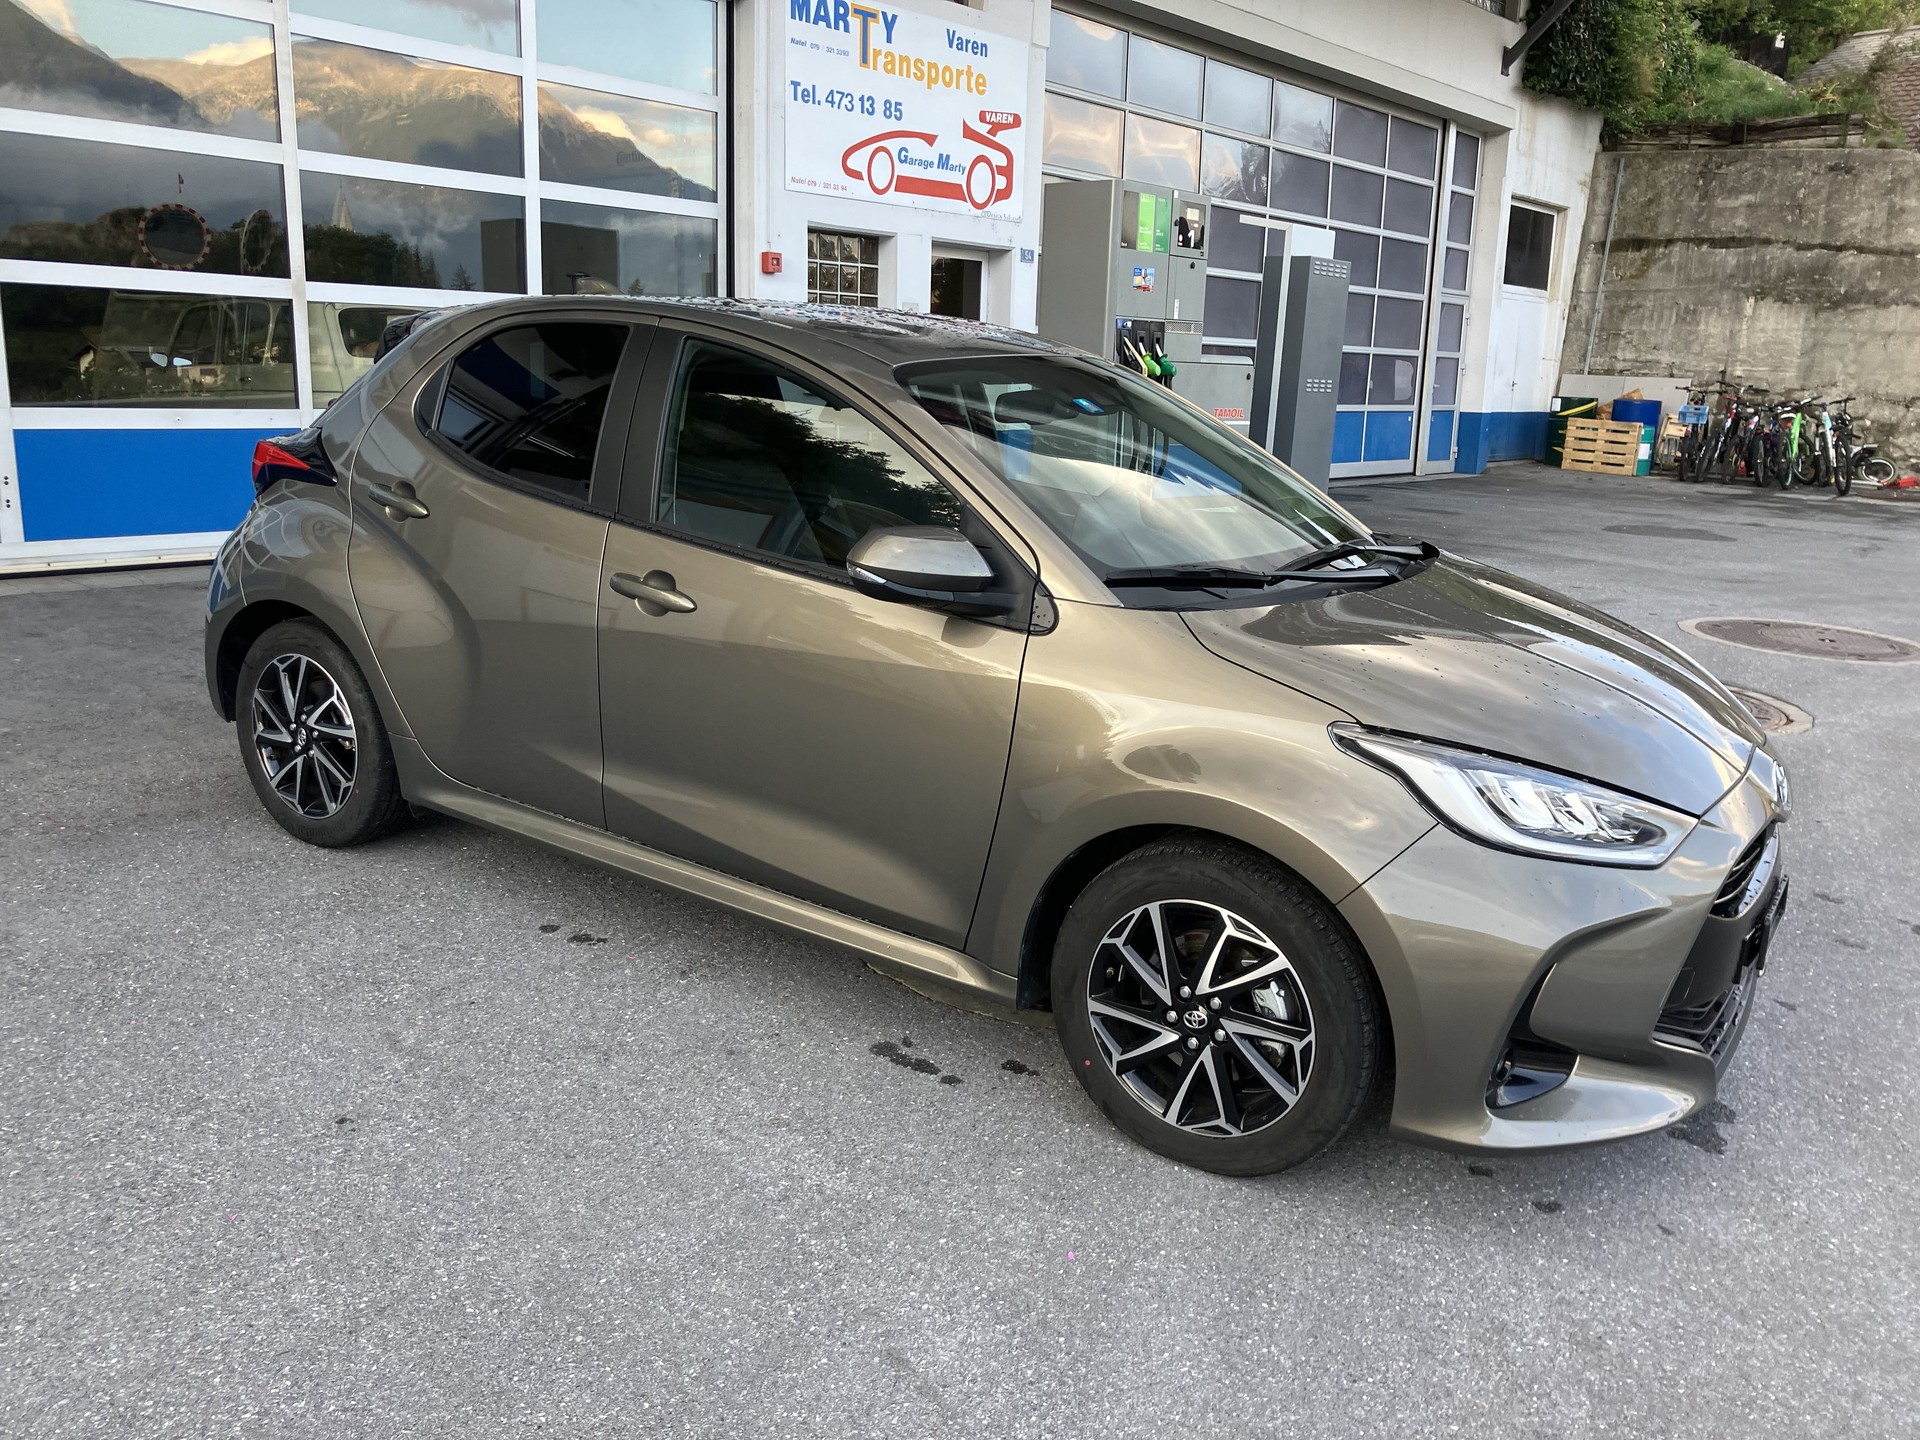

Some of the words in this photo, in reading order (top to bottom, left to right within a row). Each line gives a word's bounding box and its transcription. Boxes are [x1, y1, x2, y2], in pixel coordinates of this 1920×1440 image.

[790, 37, 807, 47] Natel
[791, 0, 898, 64] MARTY
[946, 28, 988, 58] Varen
[851, 3, 987, 96] Transporte
[790, 80, 821, 106] Tel.
[825, 89, 854, 112] 473
[858, 94, 875, 116] 13
[883, 99, 903, 121] 85
[985, 111, 1014, 124] VAREN
[897, 146, 934, 170] Garage
[937, 153, 966, 176] Marty
[790, 176, 806, 185] Natel
[1187, 229, 1196, 248] 1
[1213, 408, 1245, 419] TAMOIL
